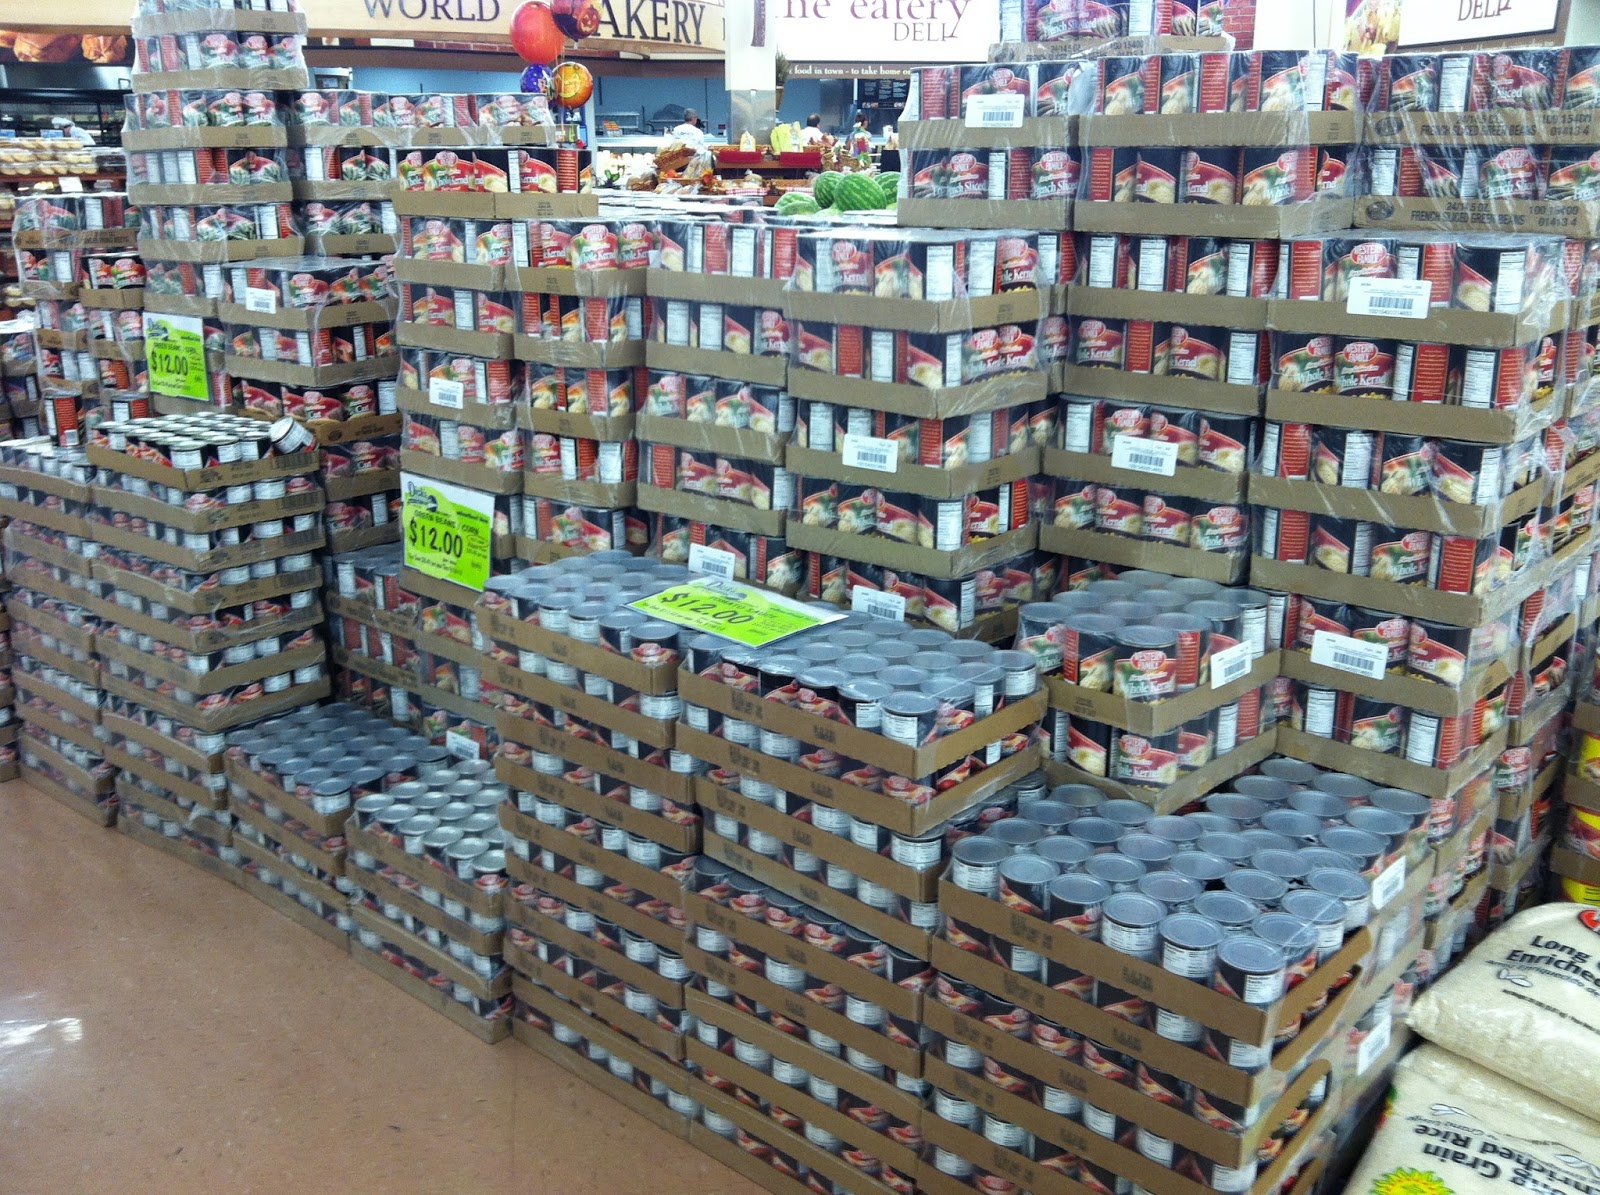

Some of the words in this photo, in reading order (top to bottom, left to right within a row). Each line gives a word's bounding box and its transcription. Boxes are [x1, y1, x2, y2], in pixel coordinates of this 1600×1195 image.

[363, 0, 500, 22] WORLD
[591, 0, 706, 45] AKERY
[893, 22, 948, 42] DELI
[794, 65, 812, 75] food
[824, 66, 844, 75] town
[851, 66, 859, 75] to
[861, 65, 878, 75] take
[880, 65, 901, 75] home
[151, 350, 188, 376] $12.00
[409, 516, 463, 558] $12.00
[661, 592, 754, 624] $12.00
[1528, 934, 1594, 965] Long
[1413, 1123, 1472, 1150] Rice
[1421, 1142, 1502, 1180] Grain
[1479, 1140, 1600, 1195] nriched
